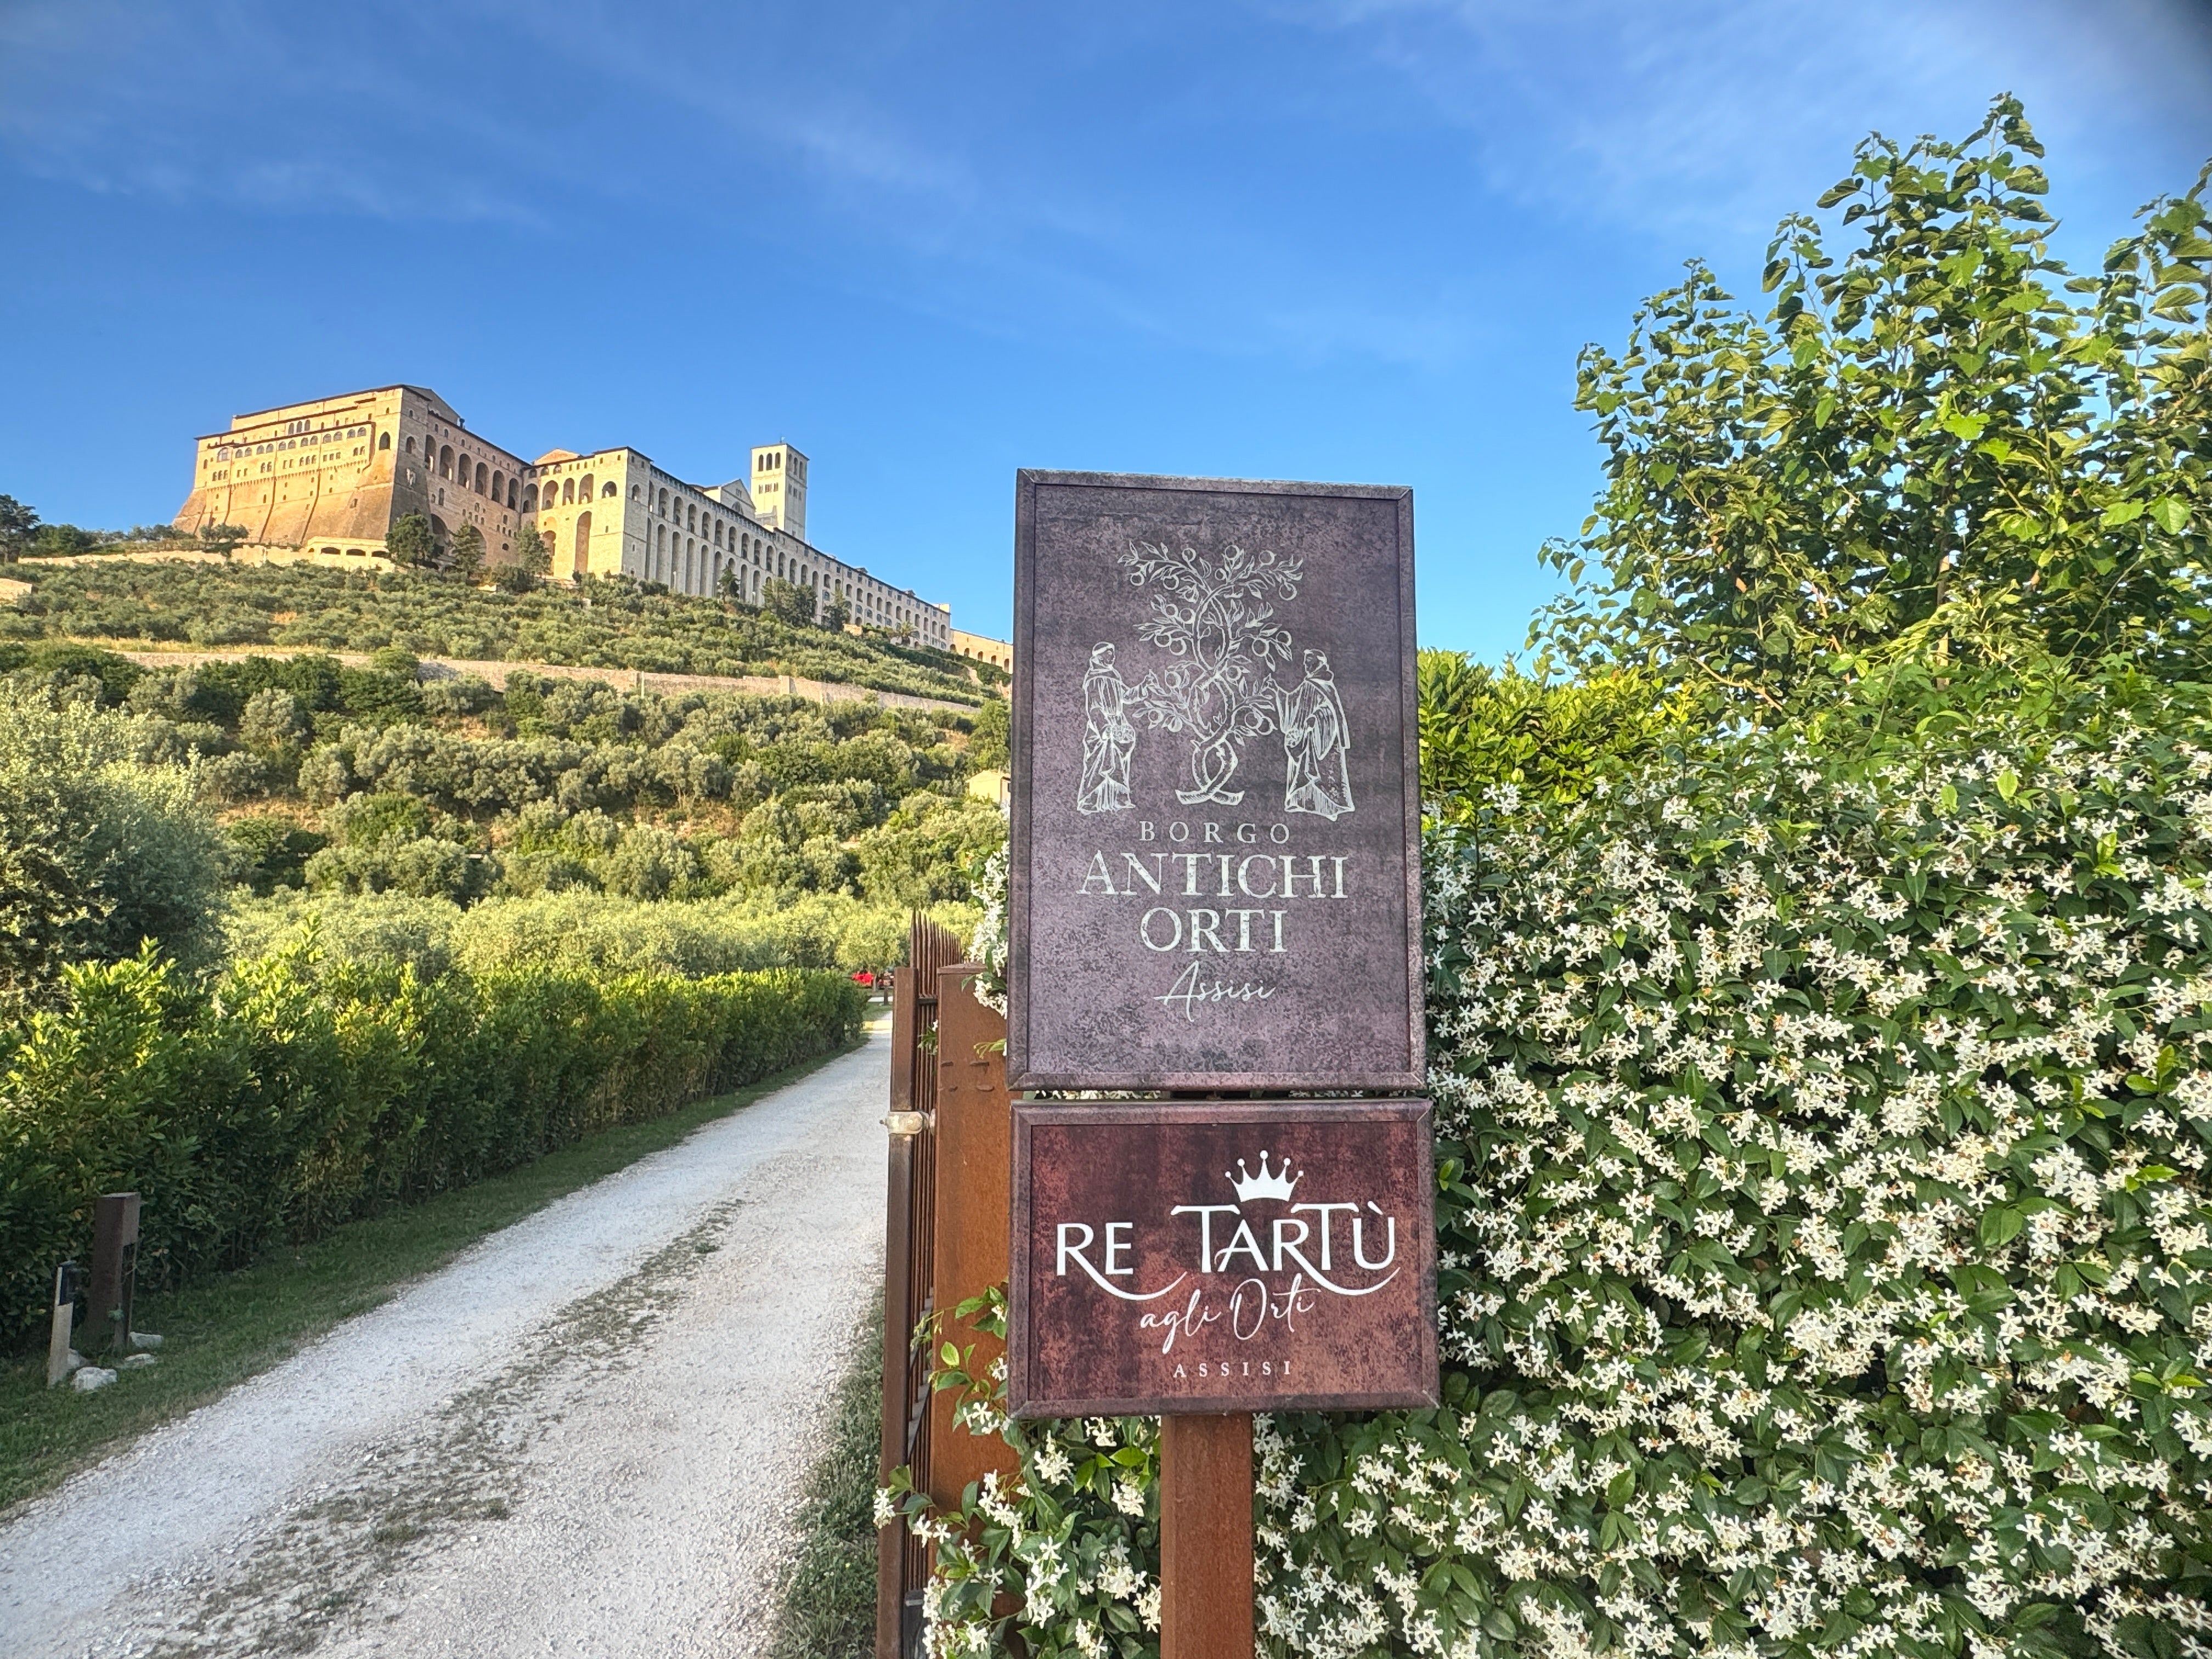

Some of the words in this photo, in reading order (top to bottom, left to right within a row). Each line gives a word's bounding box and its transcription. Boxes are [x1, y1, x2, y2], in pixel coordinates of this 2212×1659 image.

[1139, 821, 1289, 843] BORGO
[1076, 849, 1349, 900] ANTICHI
[1139, 907, 1288, 953] ORTI
[1154, 960, 1277, 1023] Assisi
[1170, 1200, 1401, 1296] TARTÙ
[1140, 1289, 1222, 1355] agli
[1229, 1273, 1321, 1340] Orti
[1173, 1361, 1291, 1379] ASSISI
